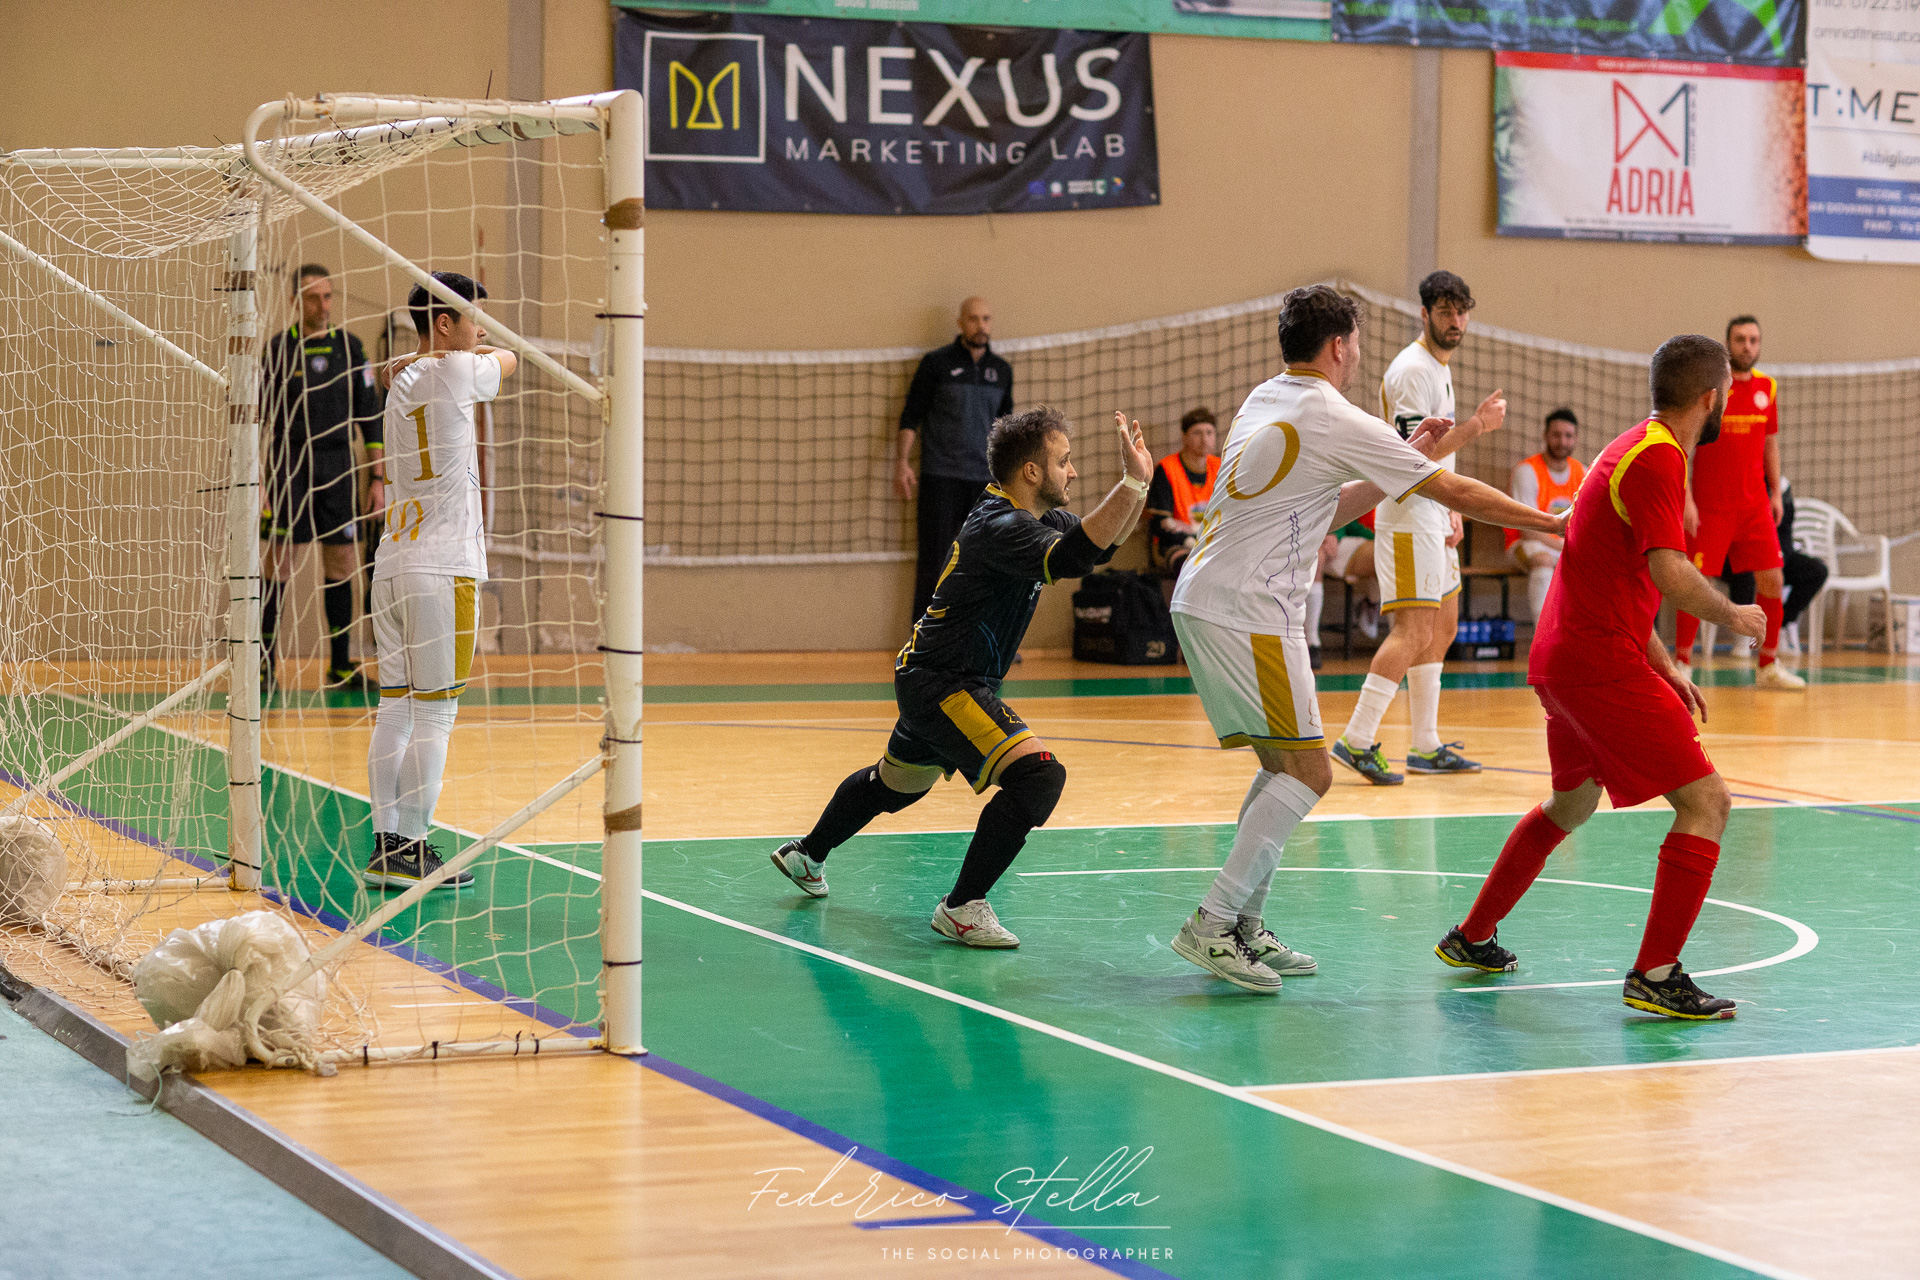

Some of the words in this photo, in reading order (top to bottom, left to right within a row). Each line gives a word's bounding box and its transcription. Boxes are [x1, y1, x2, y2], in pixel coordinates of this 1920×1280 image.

[784, 43, 1122, 128] NEXUS
[785, 137, 1026, 165] MARKETING
[1050, 134, 1126, 161] LAB
[1606, 167, 1695, 216] ADRIA
